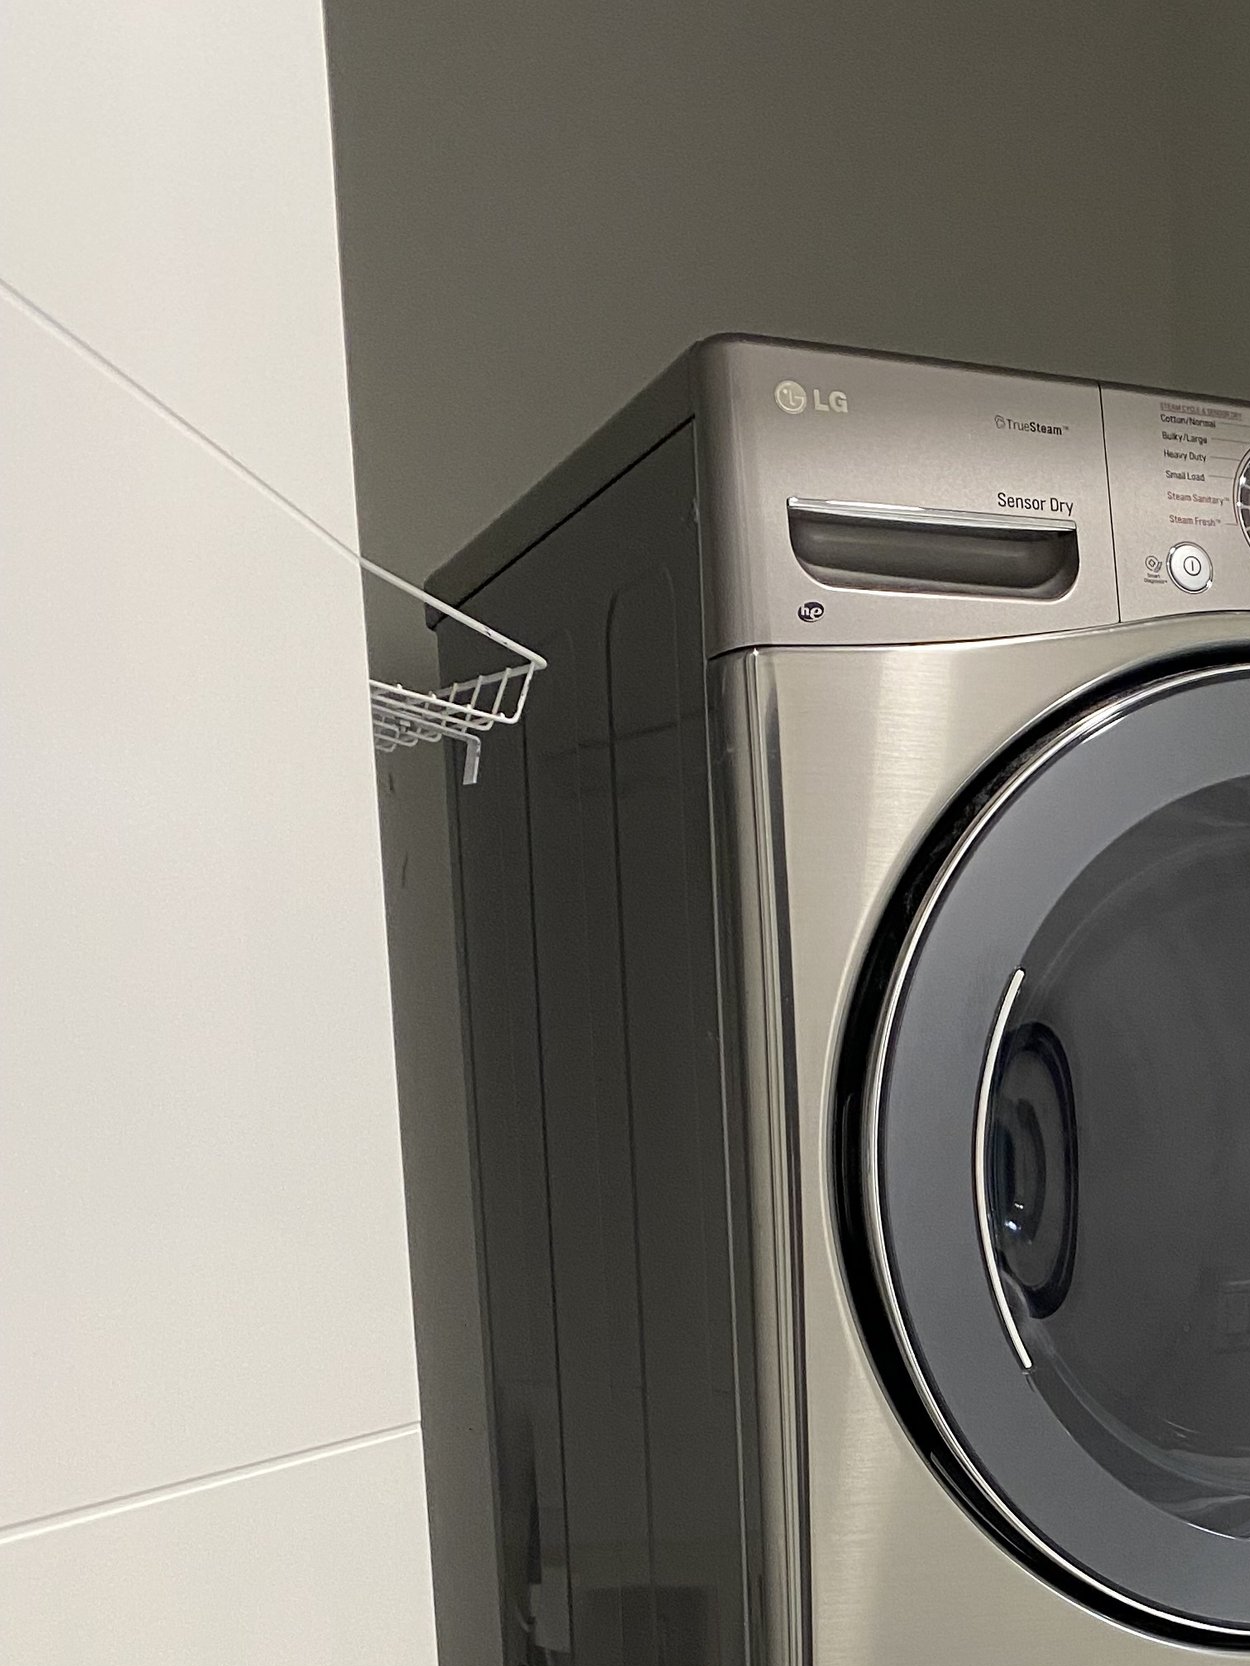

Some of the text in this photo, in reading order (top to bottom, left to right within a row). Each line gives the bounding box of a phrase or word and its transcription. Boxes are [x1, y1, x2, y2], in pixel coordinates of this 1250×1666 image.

[814, 389, 848, 414] LG
[1160, 413, 1216, 428] Cotton/Normal
[1161, 431, 1208, 445] Bulky/Large
[1163, 449, 1207, 463] Heavy Duty
[1165, 470, 1206, 482] Small Load
[1167, 491, 1192, 502] Steam
[997, 492, 1074, 517] Sensor Dry
[1169, 514, 1193, 525] Steam
